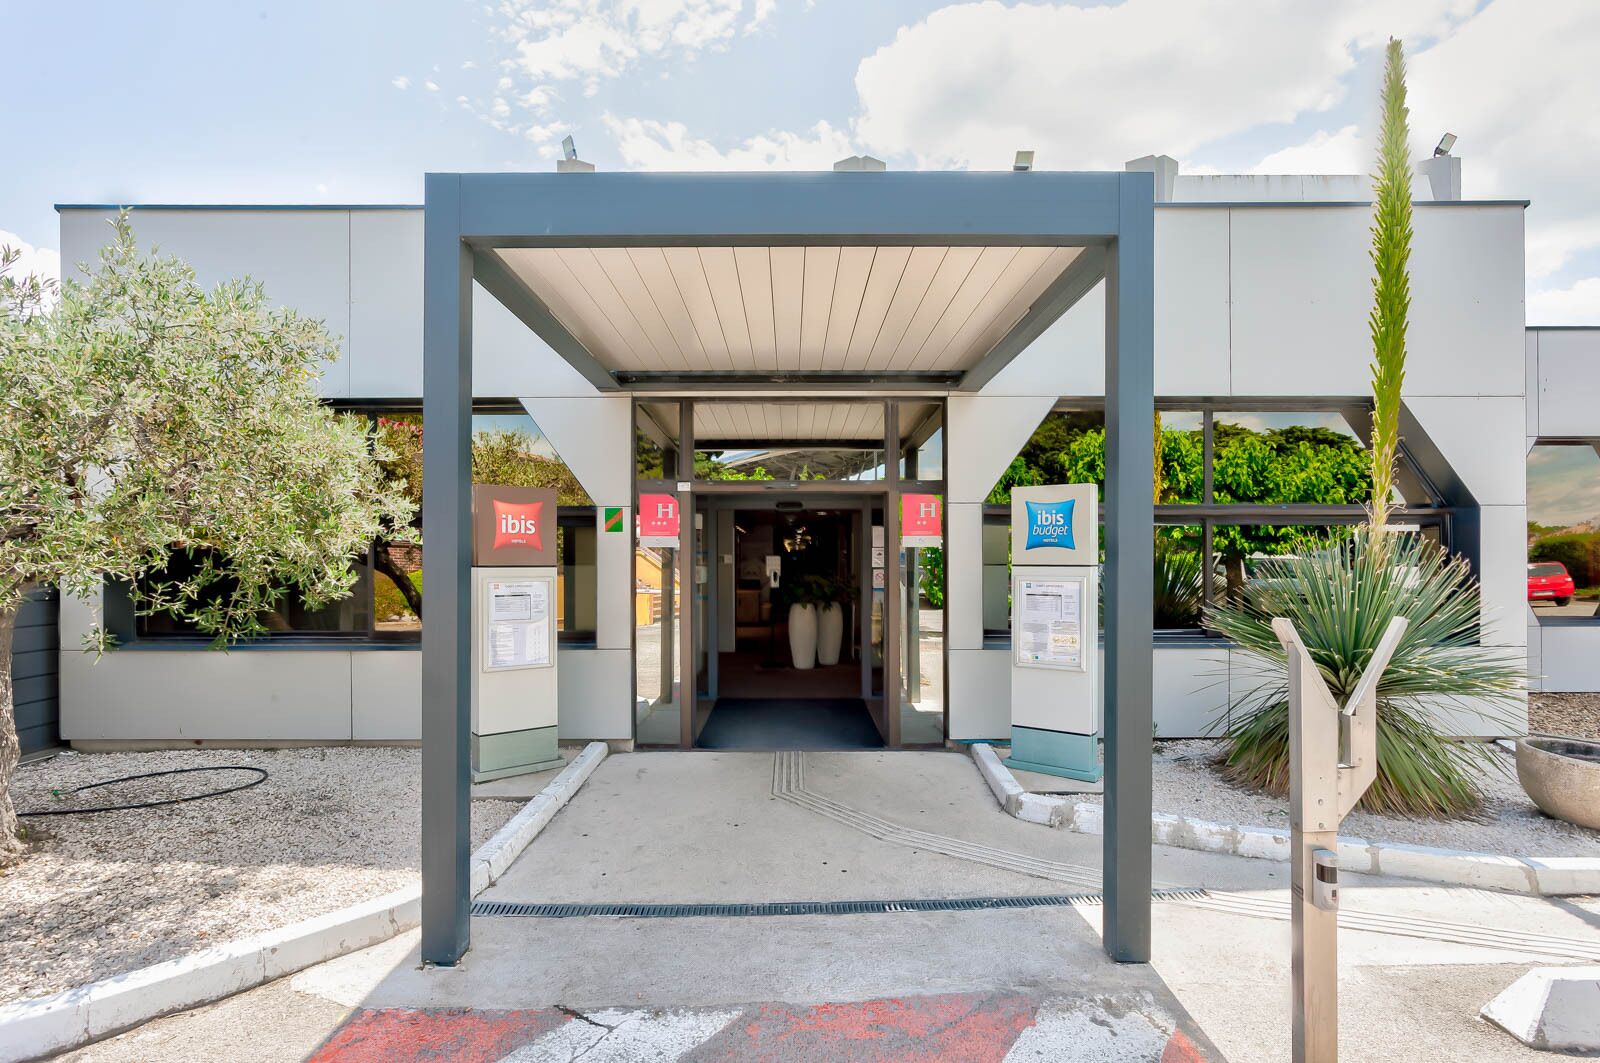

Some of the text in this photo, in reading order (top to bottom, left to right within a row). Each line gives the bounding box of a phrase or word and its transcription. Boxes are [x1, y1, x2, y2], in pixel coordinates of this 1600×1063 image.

[657, 503, 673, 519] H
[919, 502, 936, 518] H
[1037, 510, 1064, 525] ibis
[501, 513, 536, 535] ibis
[1032, 525, 1069, 538] budget
